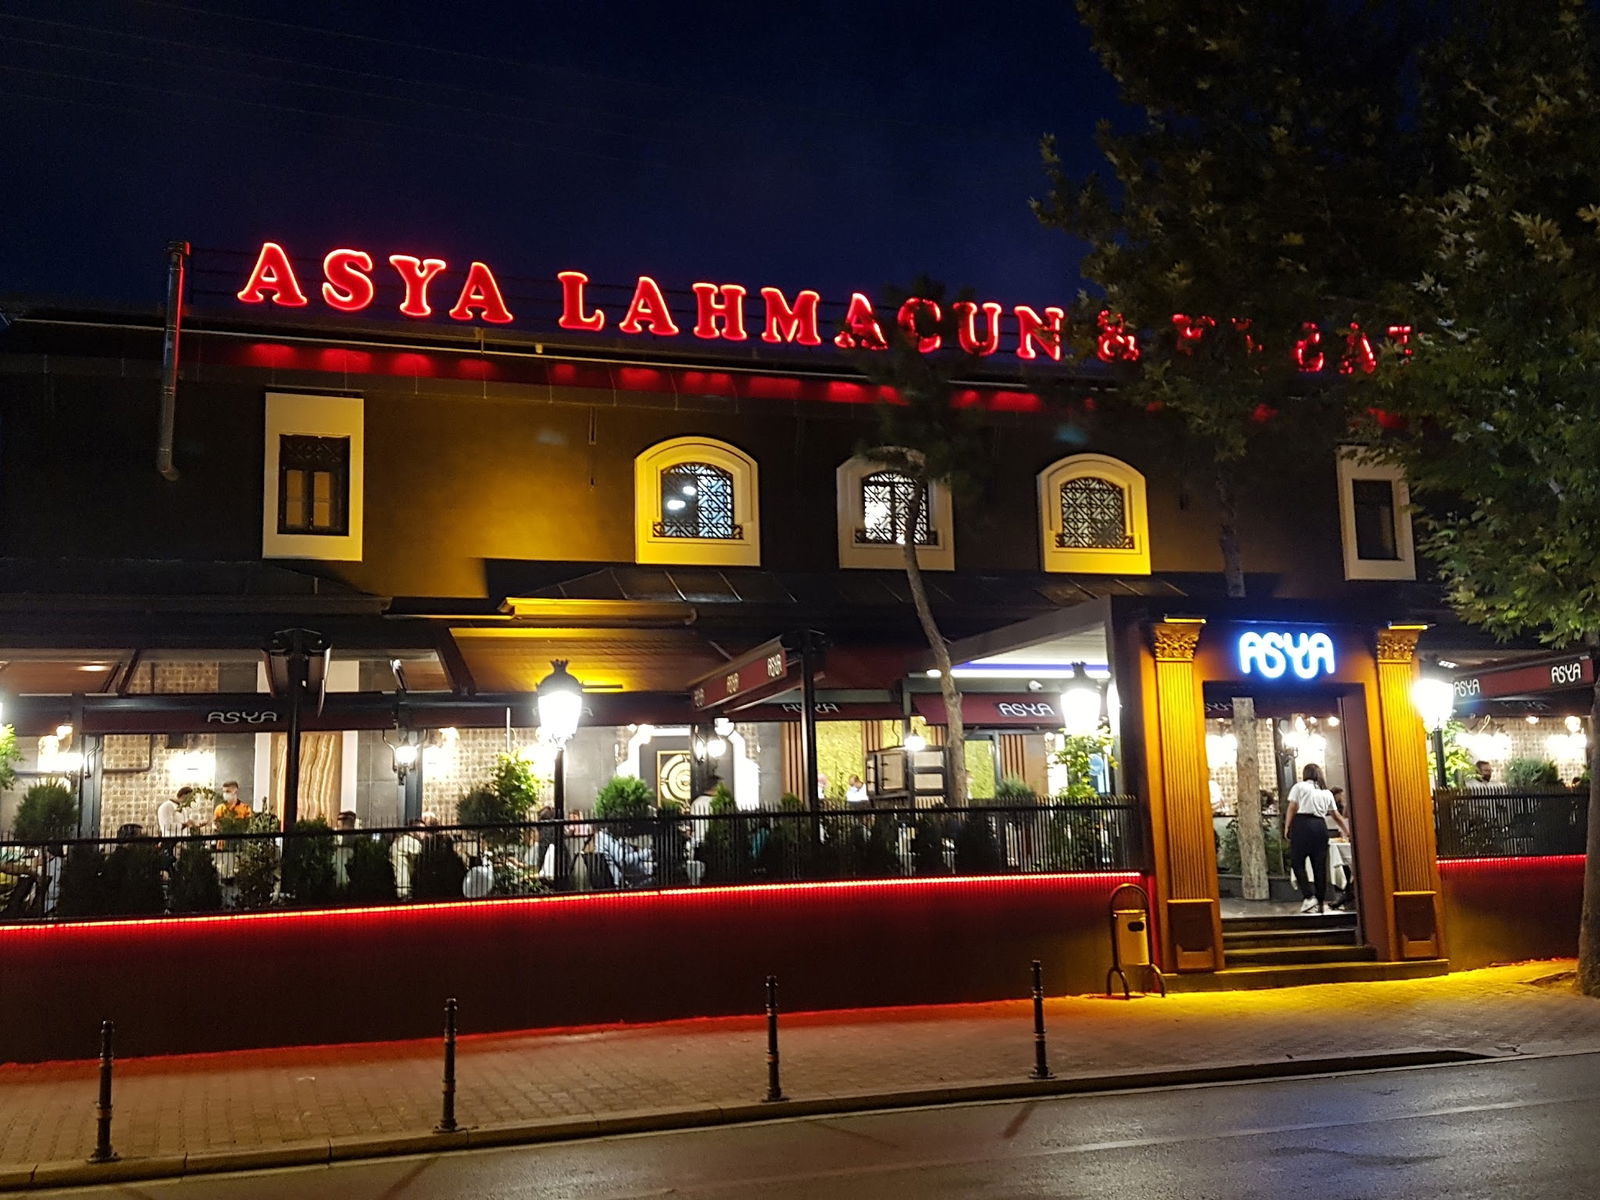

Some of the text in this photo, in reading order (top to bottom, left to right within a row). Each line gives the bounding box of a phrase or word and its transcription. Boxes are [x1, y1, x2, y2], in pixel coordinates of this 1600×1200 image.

[237, 242, 514, 324] ASYA
[557, 271, 1064, 361] LAHMACUN
[1239, 631, 1336, 679] ASYA
[1551, 662, 1582, 684] ASYA
[1454, 678, 1481, 697] ASYA
[207, 711, 278, 724] ASYA
[999, 702, 1056, 717] ASYA
